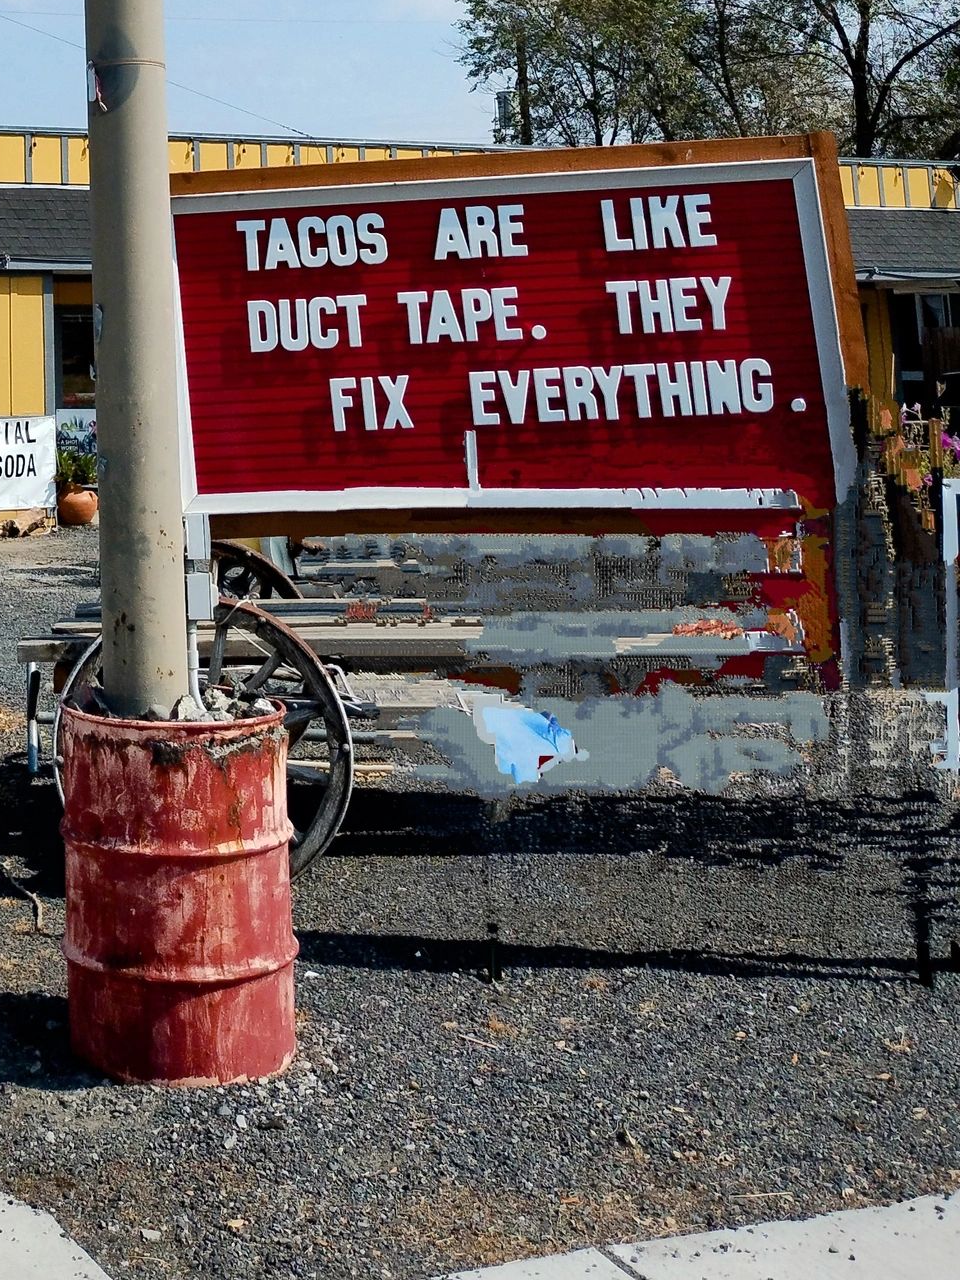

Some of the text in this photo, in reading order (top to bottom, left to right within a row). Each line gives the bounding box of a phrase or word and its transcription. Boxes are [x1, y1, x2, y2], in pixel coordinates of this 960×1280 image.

[236, 193, 718, 272] TACOS ARE LIKE
[247, 276, 733, 353] DUCT TAPE. THEY
[328, 374, 414, 432] FIX
